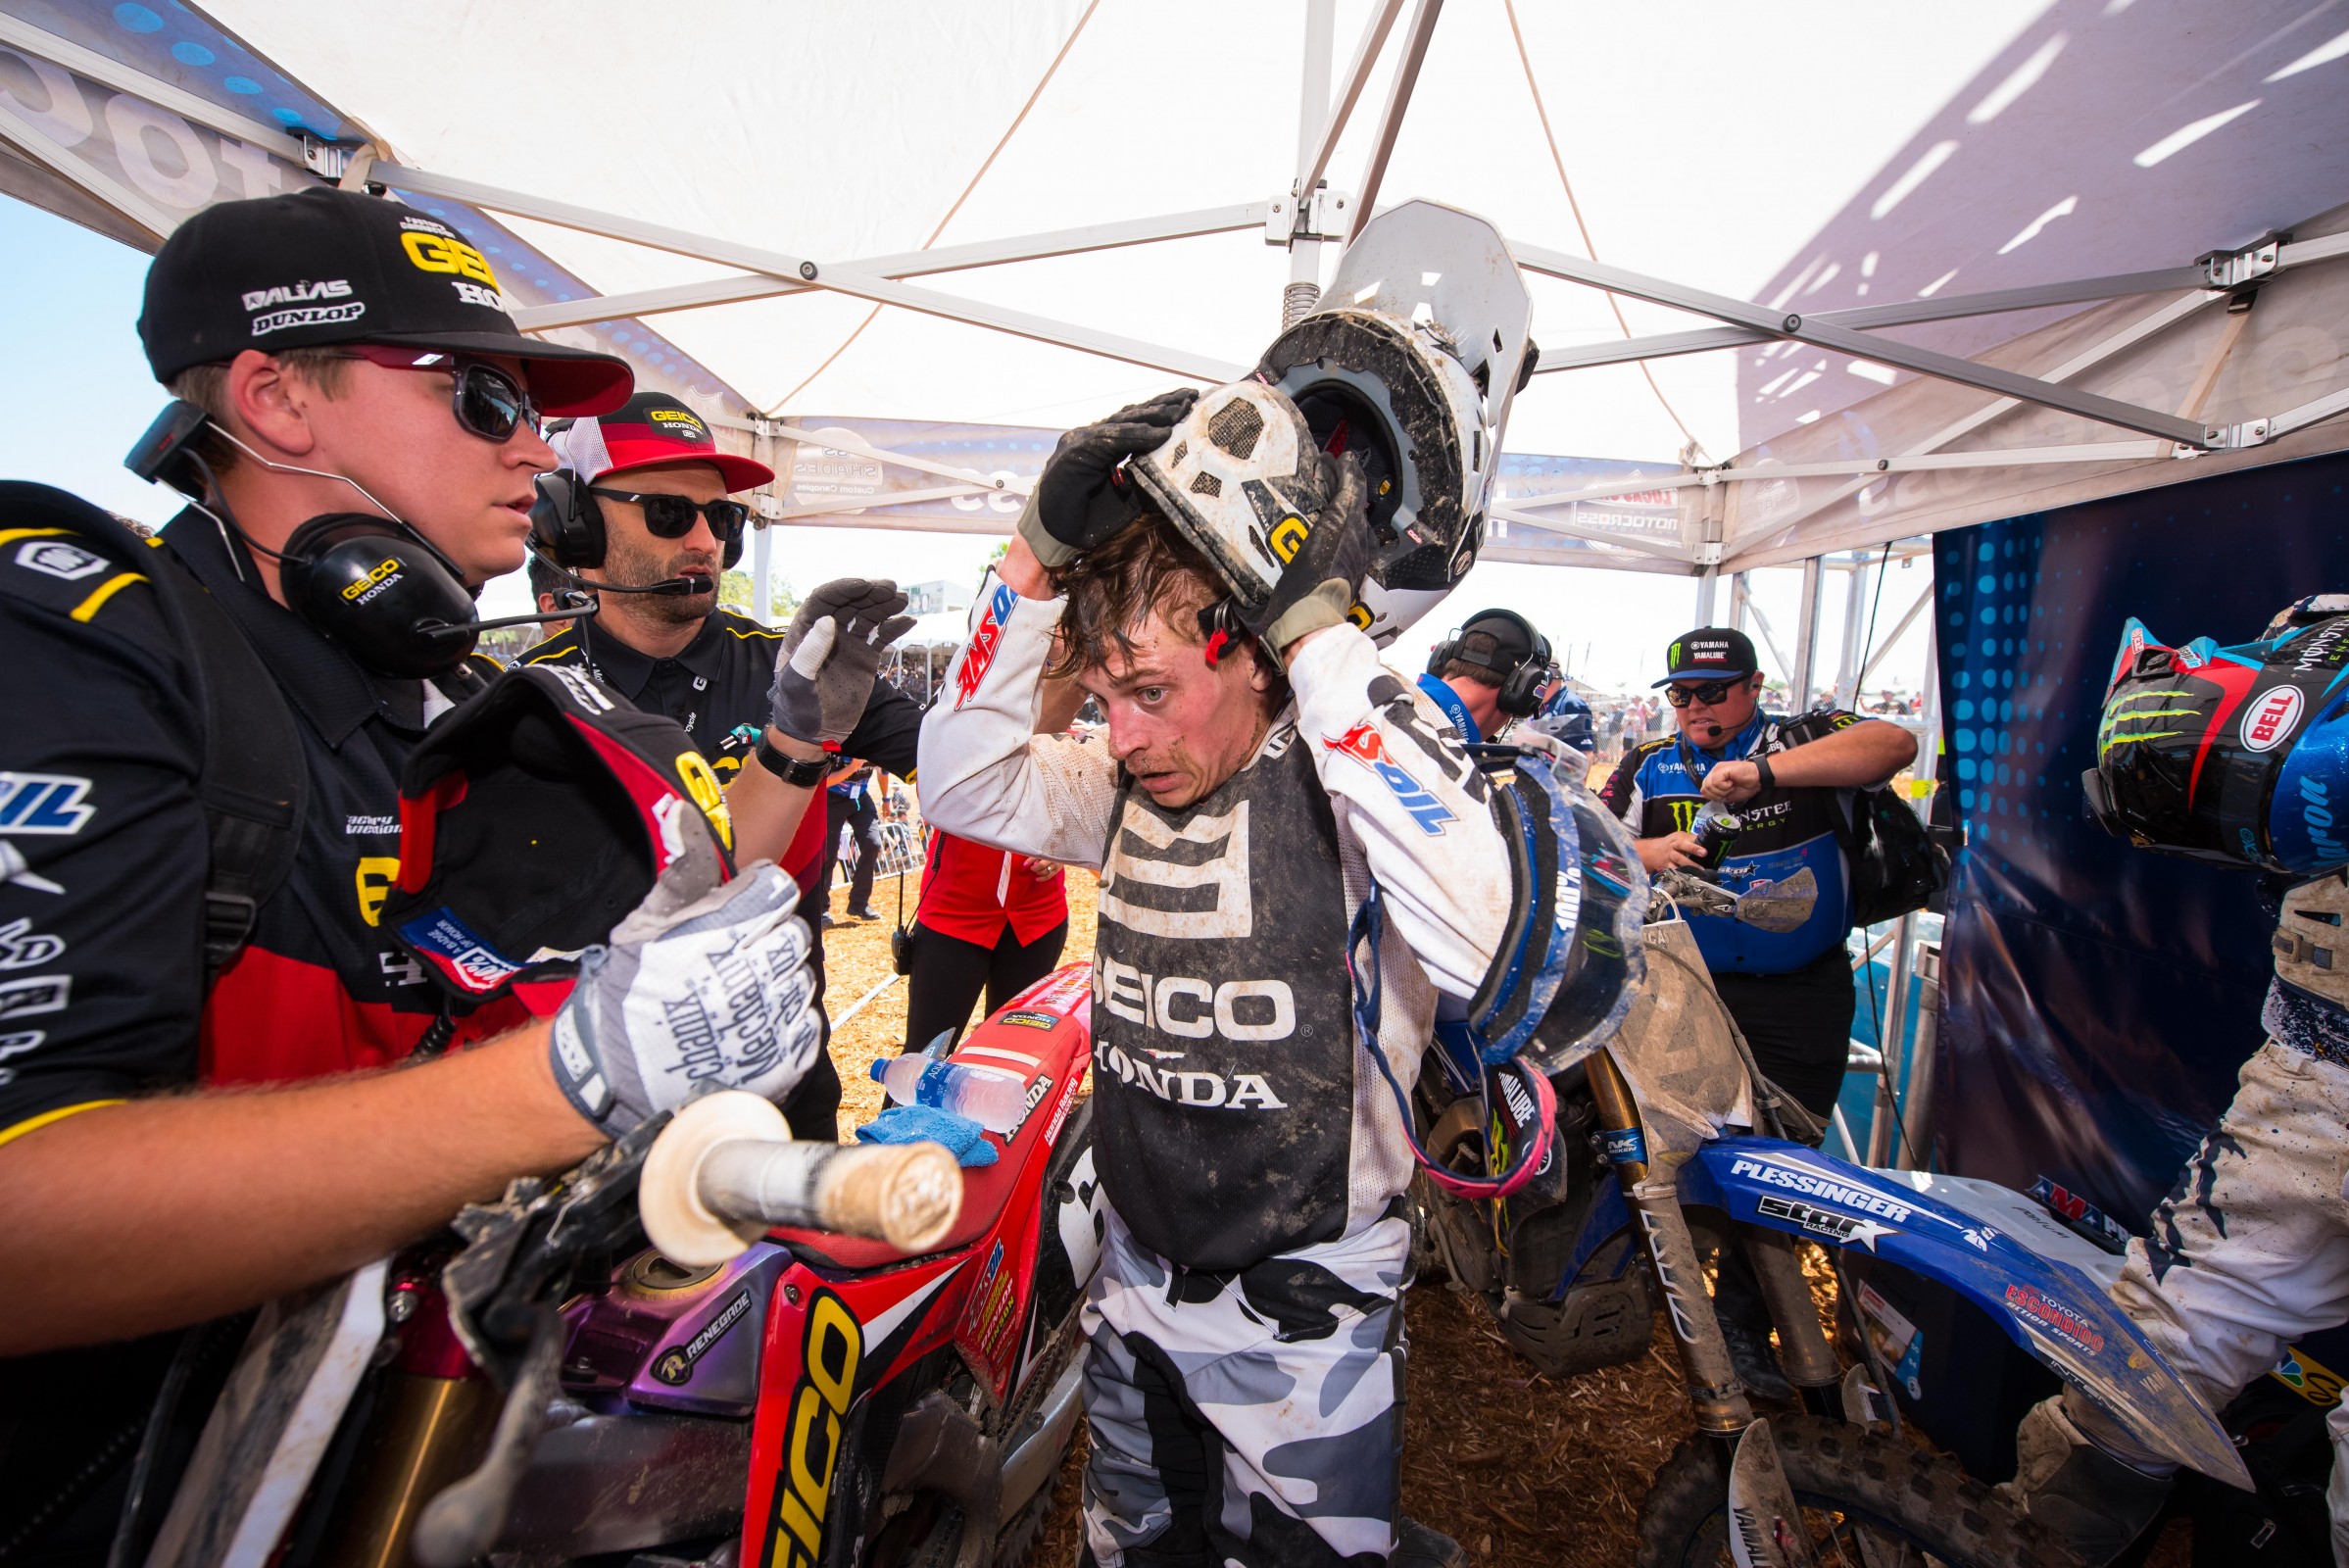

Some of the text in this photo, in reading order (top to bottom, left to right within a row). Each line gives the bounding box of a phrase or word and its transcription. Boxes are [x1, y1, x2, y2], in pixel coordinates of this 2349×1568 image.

[252, 303, 366, 336] DUNLOP
[651, 411, 703, 430] GEICO
[662, 422, 704, 434] HONDA
[341, 558, 400, 601] GEICO
[356, 572, 405, 606] HONDA
[1693, 652, 1727, 661] YAMALUBE
[1699, 641, 1729, 650] YAMAHA
[2250, 694, 2294, 742] BELL
[1554, 867, 1582, 931] 100%
[427, 930, 458, 950] BADGE
[1003, 1018, 1052, 1029] GEICO
[1044, 1104, 1063, 1143] Honda
[1058, 1076, 1078, 1109] Racing
[1731, 1159, 1912, 1223] PLESSINGER
[2026, 1175, 2102, 1232] AMA
[1805, 1222, 1850, 1239] RACING
[687, 1289, 750, 1360] RENEGADE
[980, 1277, 1013, 1350] DUNLOP
[985, 1295, 1015, 1356] HINSON
[2005, 1285, 2105, 1353] ESCONDIDO
[2006, 1301, 2096, 1356] ACTION SPORTS
[2041, 1294, 2089, 1328] TOYOTA
